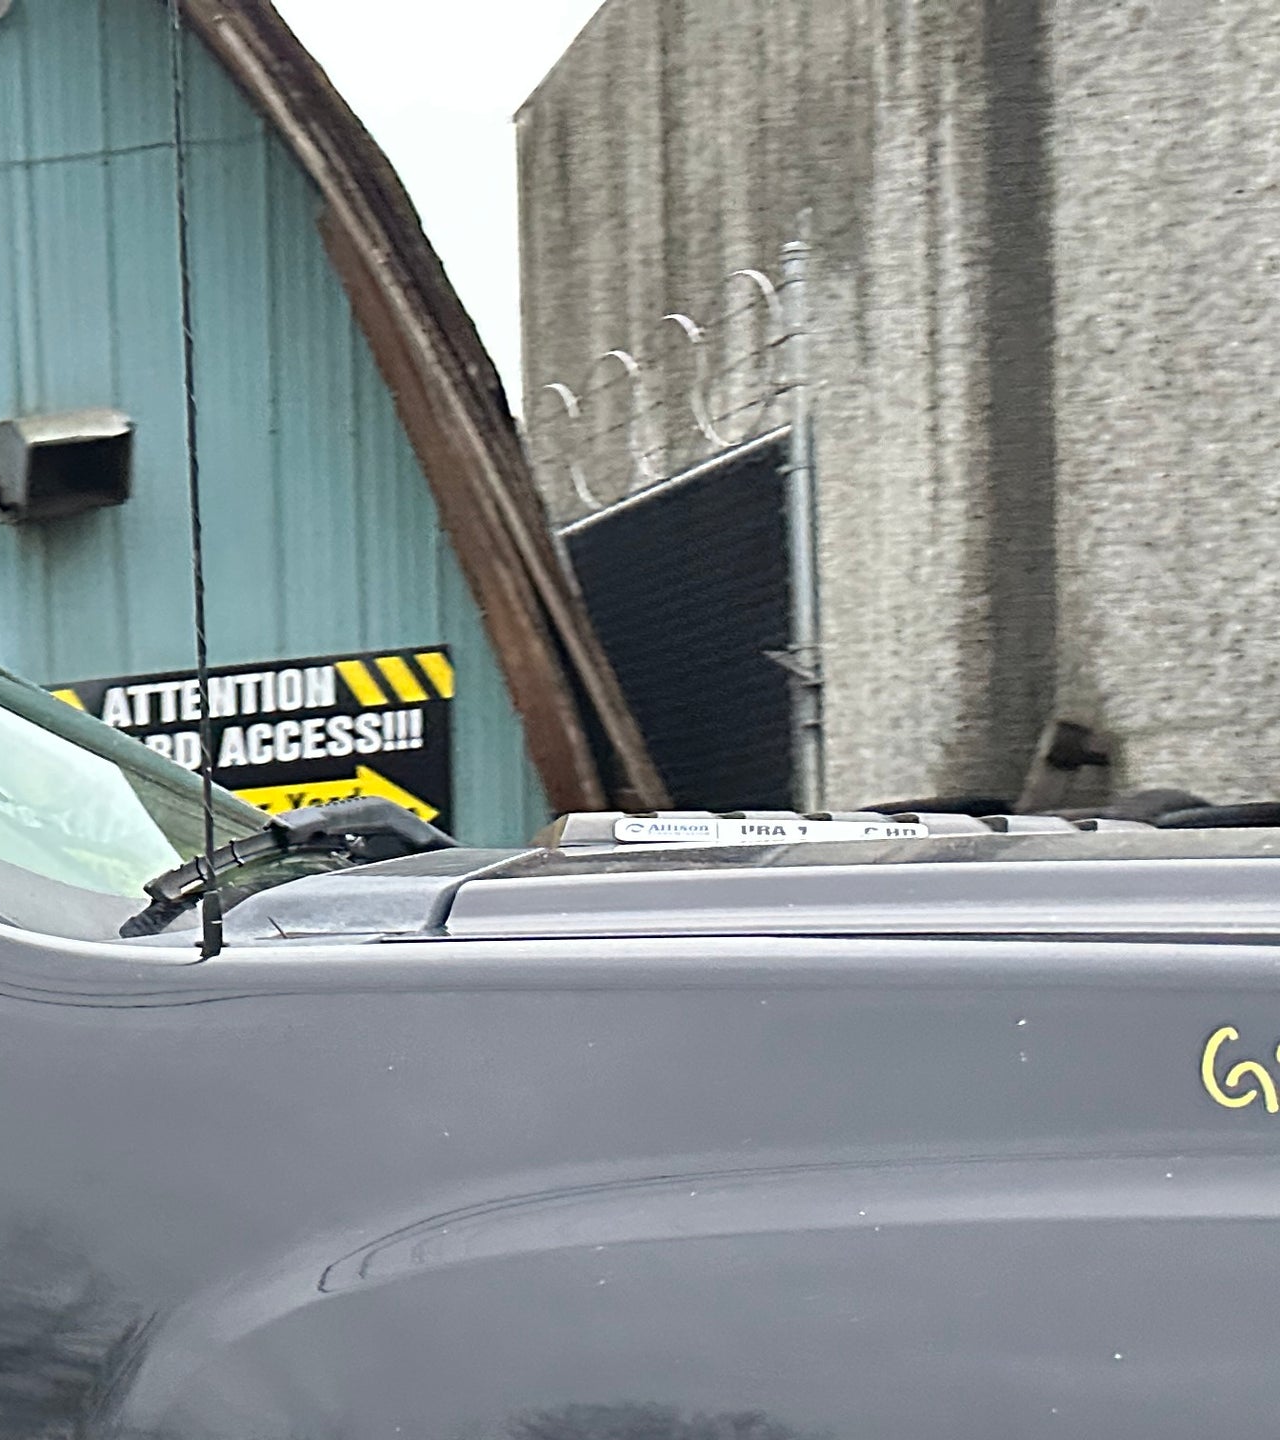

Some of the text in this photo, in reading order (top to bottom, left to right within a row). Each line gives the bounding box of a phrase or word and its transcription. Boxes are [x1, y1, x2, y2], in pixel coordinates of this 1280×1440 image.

[101, 665, 337, 728] ATTENTION
[218, 708, 425, 769] ACCESS!!!
[648, 823, 709, 832] Allison
[1202, 1026, 1280, 1114] G
